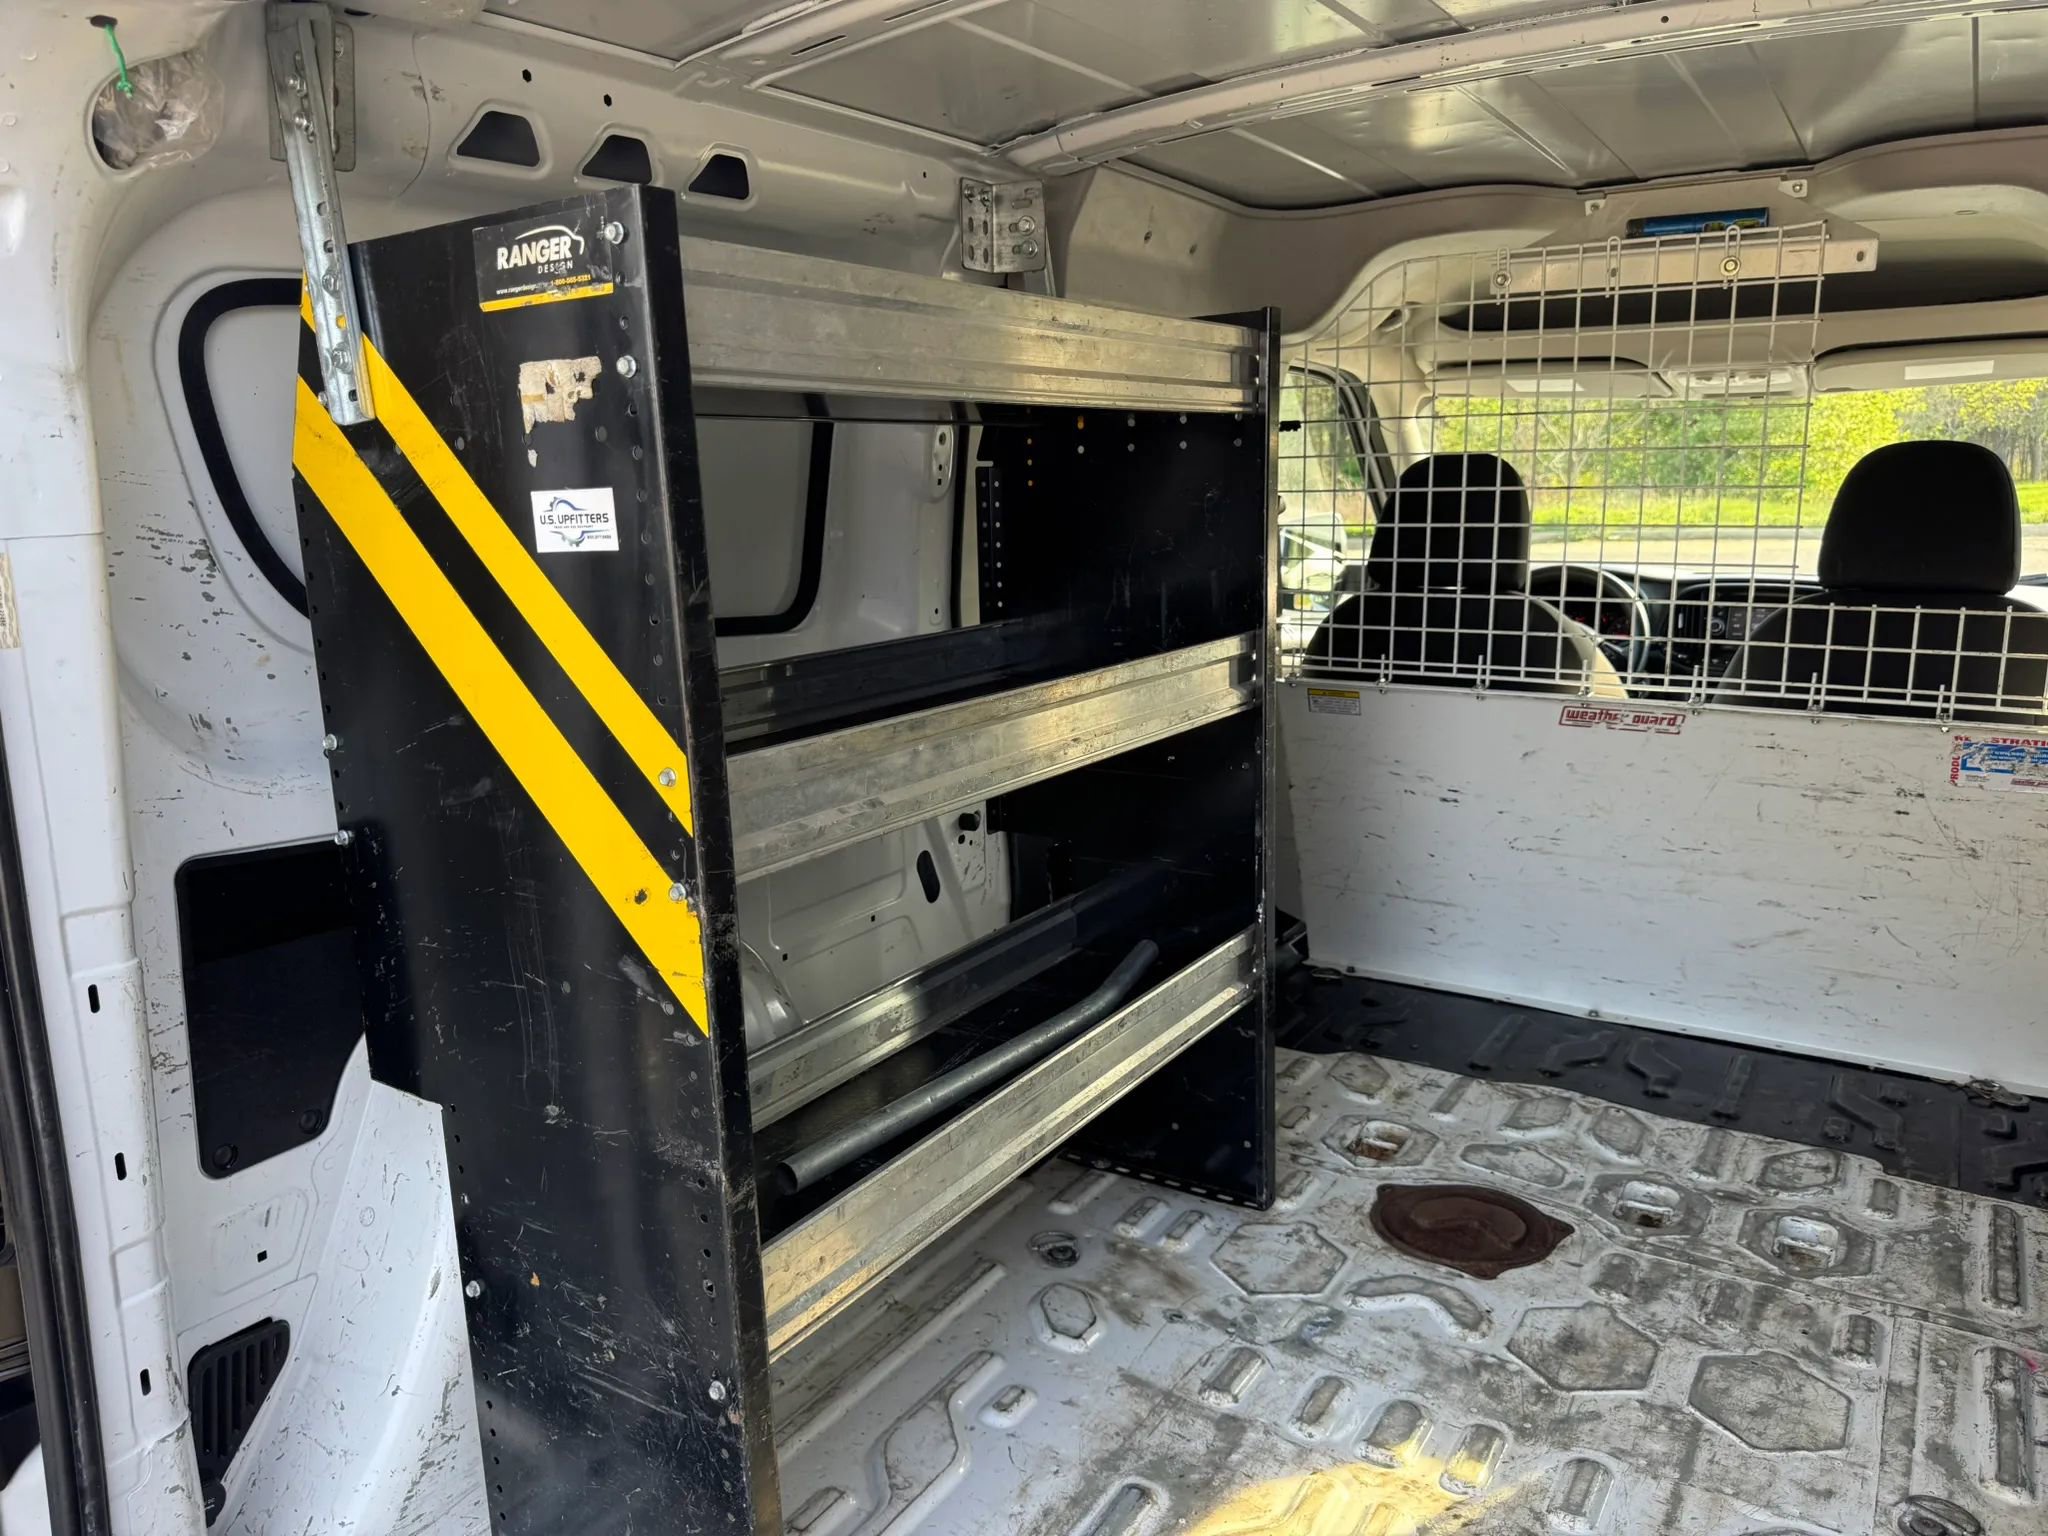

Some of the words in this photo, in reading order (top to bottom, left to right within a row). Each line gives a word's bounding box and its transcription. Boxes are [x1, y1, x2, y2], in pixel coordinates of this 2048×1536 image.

[497, 235, 573, 271] RANGER
[540, 514, 557, 525] U.S.
[558, 512, 609, 524] UPFITTERS
